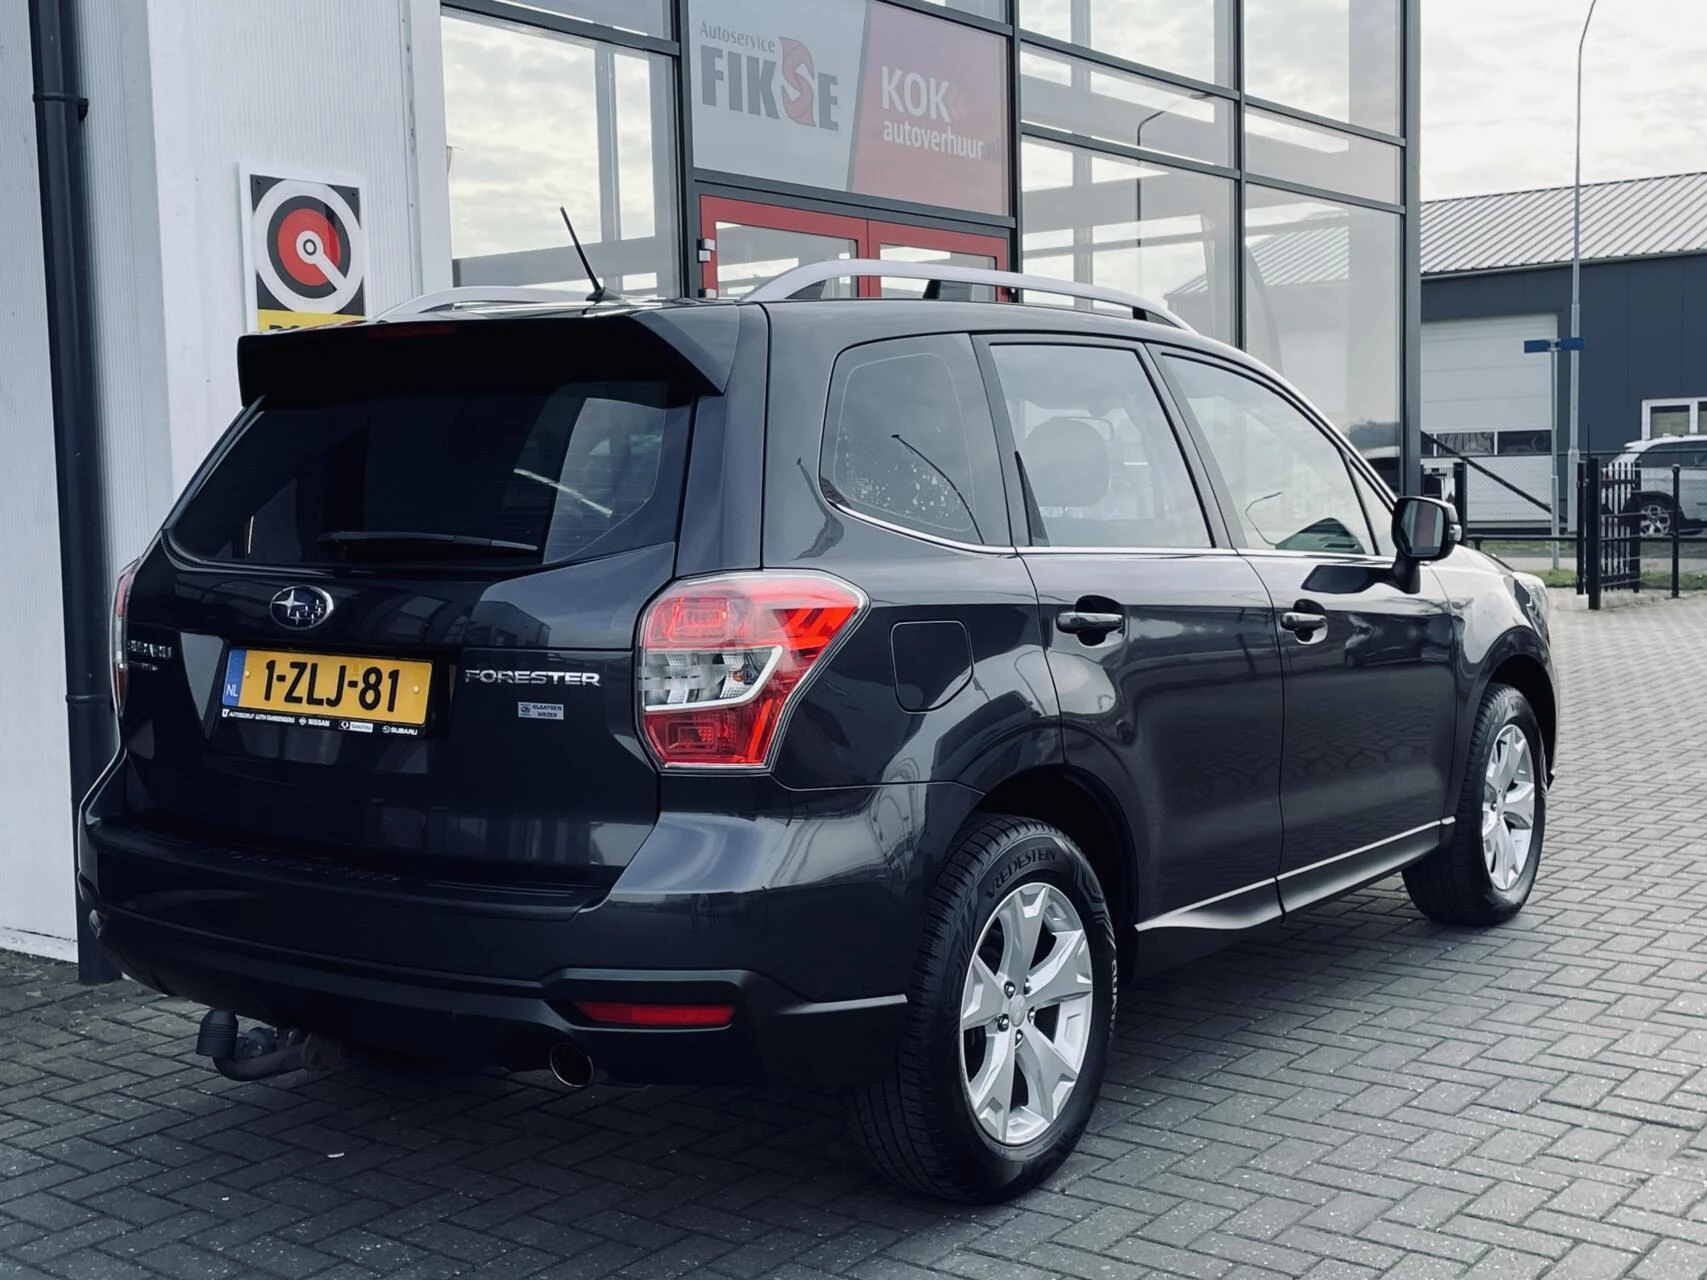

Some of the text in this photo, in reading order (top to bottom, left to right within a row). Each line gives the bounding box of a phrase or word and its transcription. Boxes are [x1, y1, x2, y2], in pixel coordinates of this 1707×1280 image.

[700, 21, 775, 53] Autoservice
[701, 36, 839, 131] FIKSE
[881, 65, 951, 123] KOK
[226, 683, 239, 698] NL
[264, 659, 400, 713] 1-ZLJ-81
[465, 669, 601, 687] FORESTER
[308, 718, 331, 727] NISSAN
[391, 727, 418, 736] SUBARU
